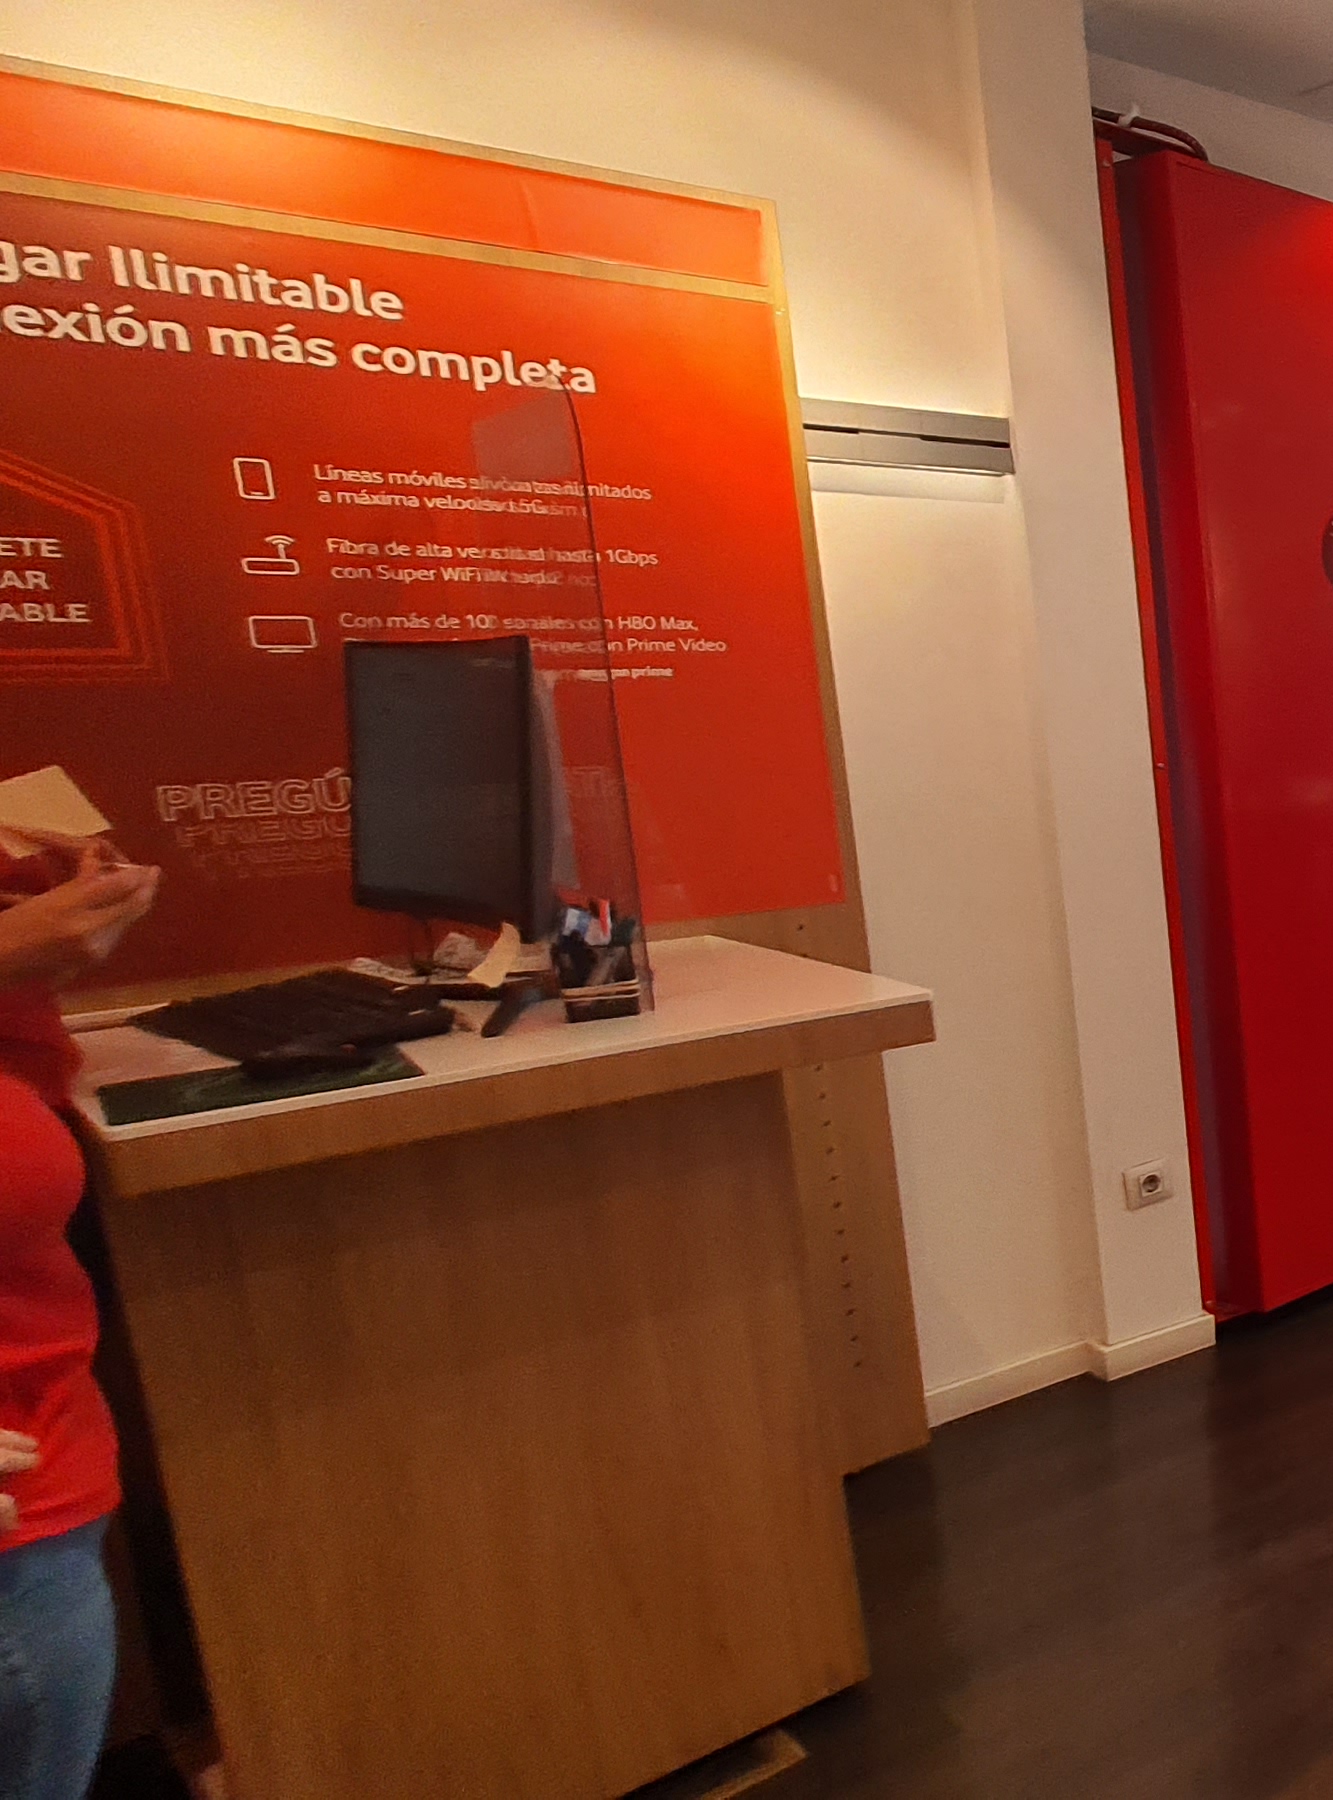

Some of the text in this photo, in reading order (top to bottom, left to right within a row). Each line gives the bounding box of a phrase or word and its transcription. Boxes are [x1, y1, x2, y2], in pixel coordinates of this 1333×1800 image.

[108, 245, 404, 320] Ilimitable
[208, 323, 338, 368] más
[351, 342, 597, 394] completa
[313, 464, 384, 484] Líneas
[388, 470, 467, 489] móviles
[318, 490, 332, 503] a
[336, 489, 420, 508] máxima
[326, 537, 380, 556] Fibra
[385, 541, 411, 556] de
[415, 542, 453, 558] alta
[605, 549, 659, 567] 1Gbps
[330, 566, 372, 580] con
[378, 565, 437, 584] Super
[338, 613, 383, 629] Con
[386, 612, 431, 629] más
[434, 615, 461, 629] de
[618, 616, 656, 631] HBO
[626, 638, 677, 652] Prime
[679, 638, 727, 652] Video
